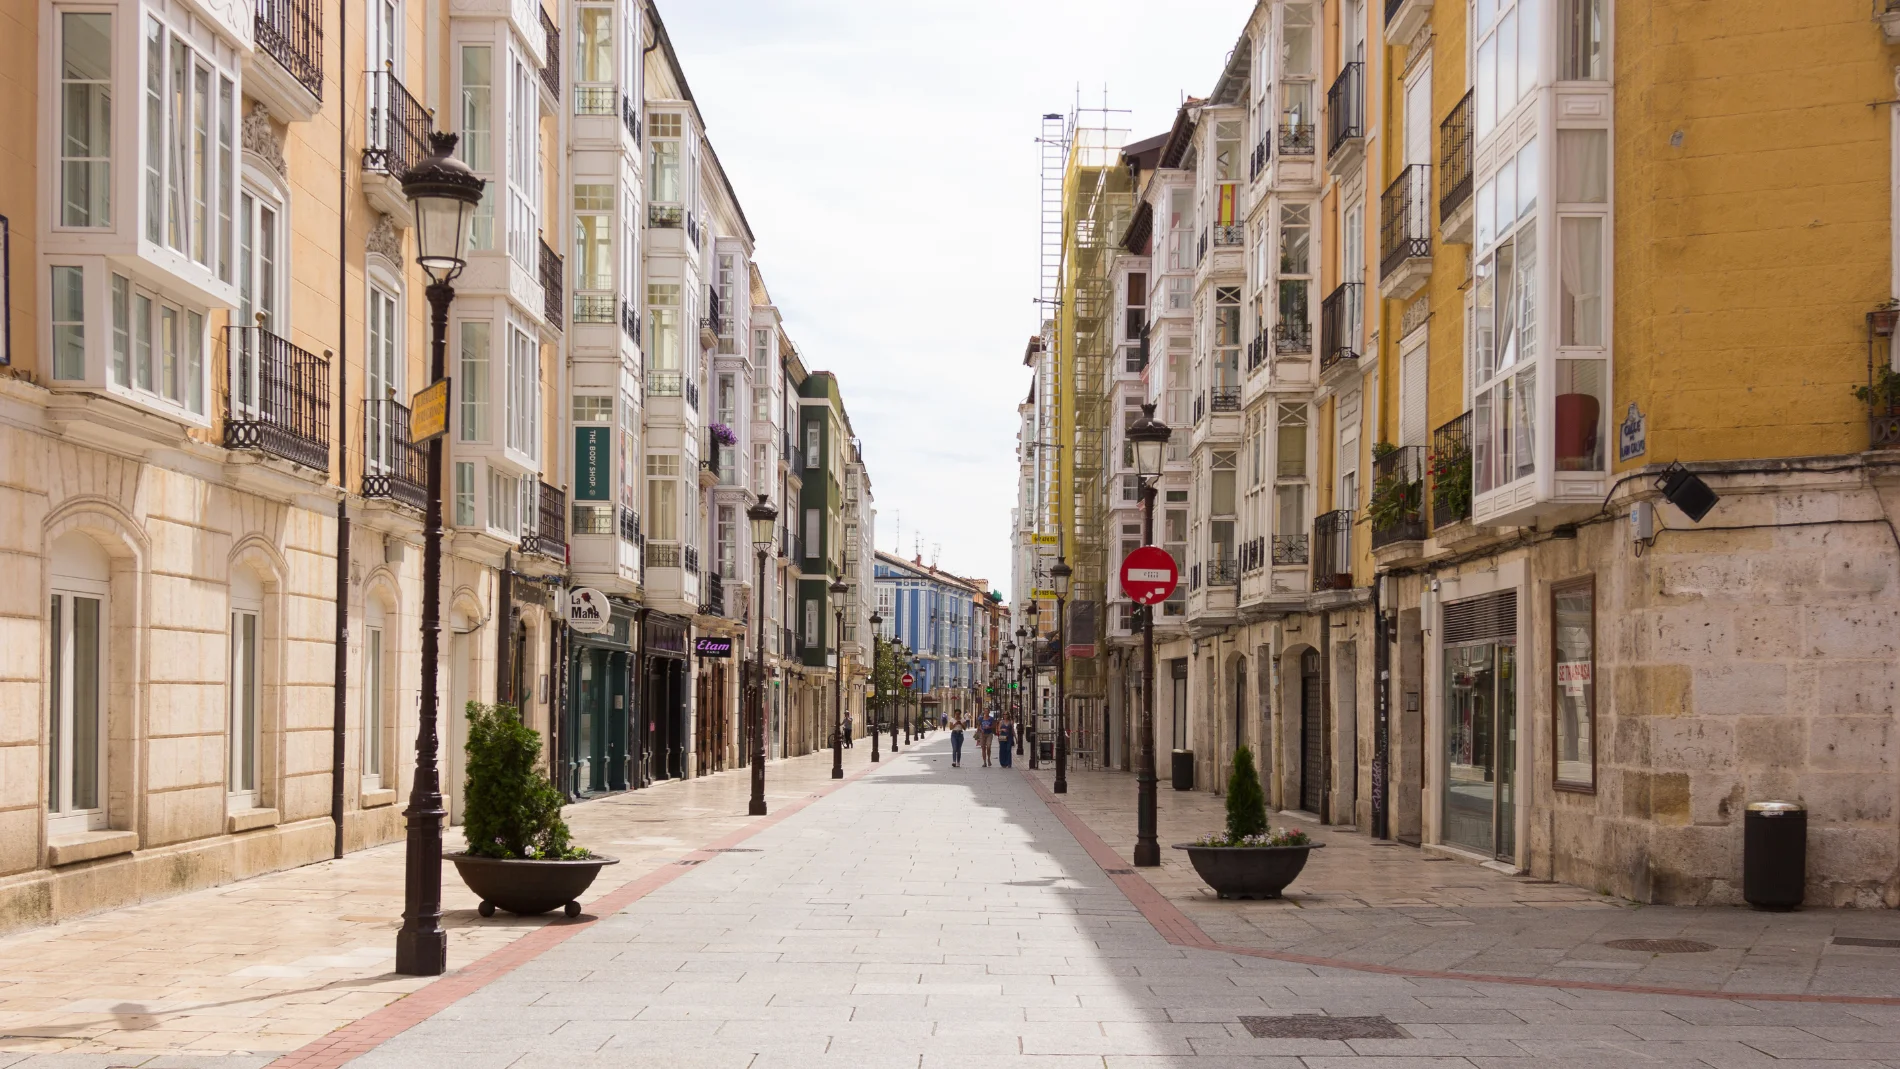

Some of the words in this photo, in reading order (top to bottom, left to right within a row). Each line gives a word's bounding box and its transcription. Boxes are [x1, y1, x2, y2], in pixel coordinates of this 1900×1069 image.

[1624, 420, 1641, 436] CALLE
[571, 595, 581, 605] La
[697, 640, 730, 651] Etam
